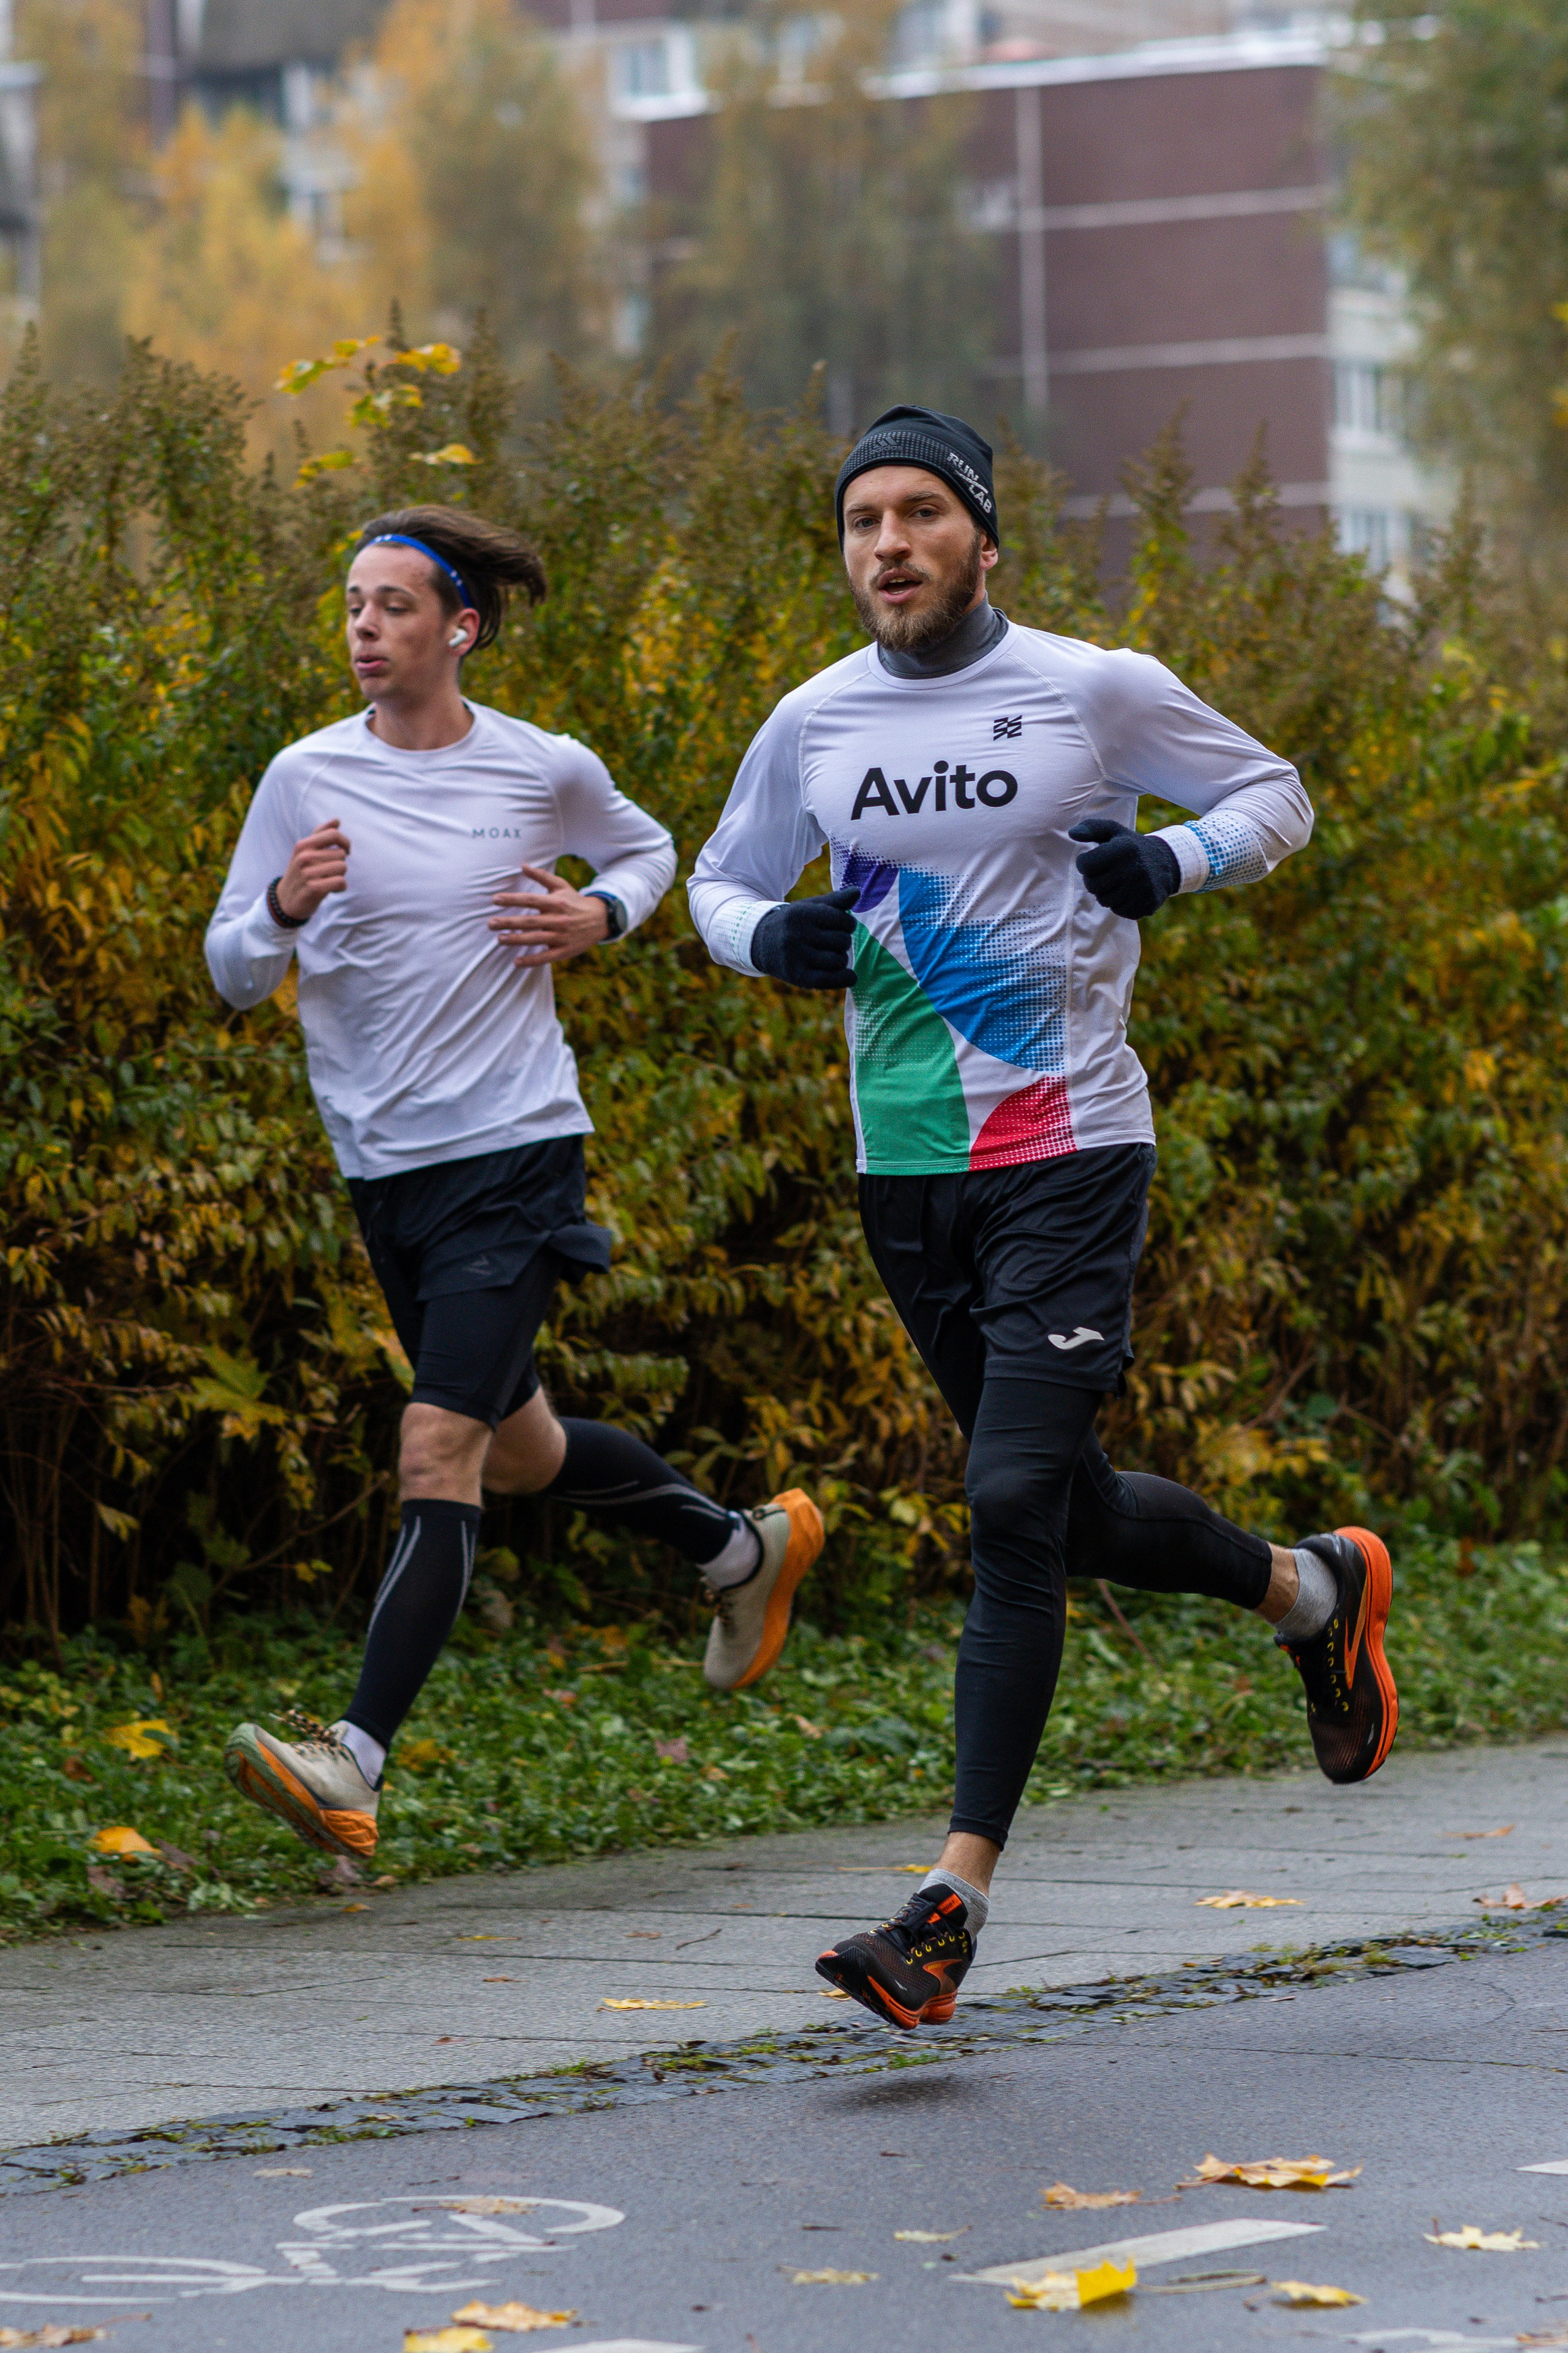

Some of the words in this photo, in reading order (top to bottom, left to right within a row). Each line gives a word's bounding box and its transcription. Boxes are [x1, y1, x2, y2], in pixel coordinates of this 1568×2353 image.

[869, 445, 903, 455] adidas
[946, 452, 979, 481] RUN
[968, 484, 992, 513] LAB
[851, 760, 1018, 821] Avito
[471, 826, 521, 839] MOAX
